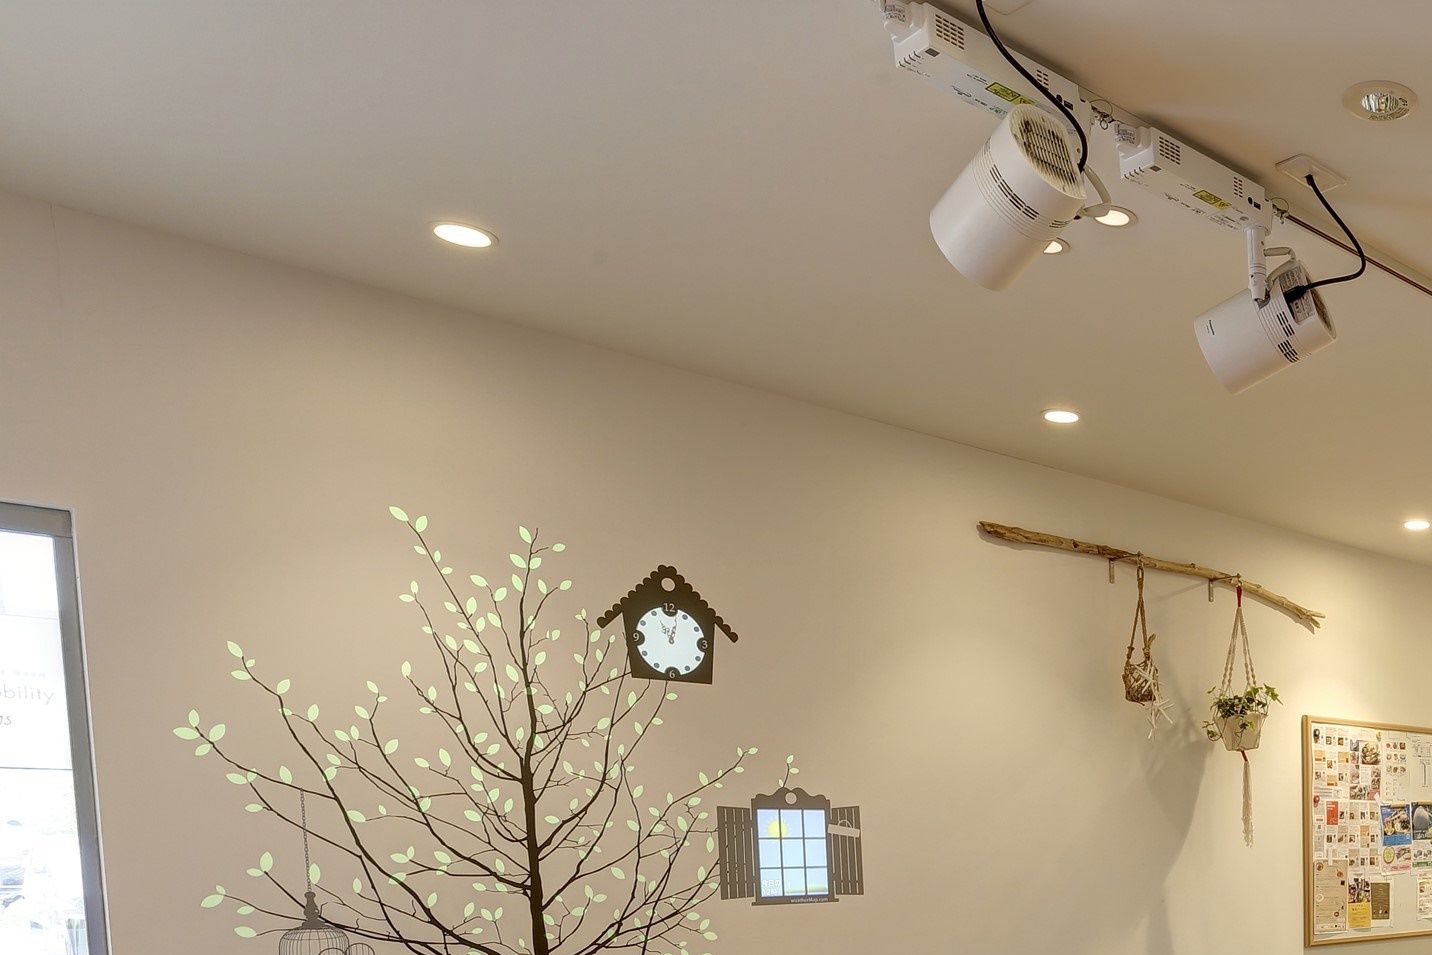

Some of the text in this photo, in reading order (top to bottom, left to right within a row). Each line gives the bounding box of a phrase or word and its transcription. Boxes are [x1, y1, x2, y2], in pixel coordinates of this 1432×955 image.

[664, 603, 676, 613] 12
[633, 633, 640, 642] 9
[701, 641, 709, 649] 3
[669, 669, 676, 678] 6
